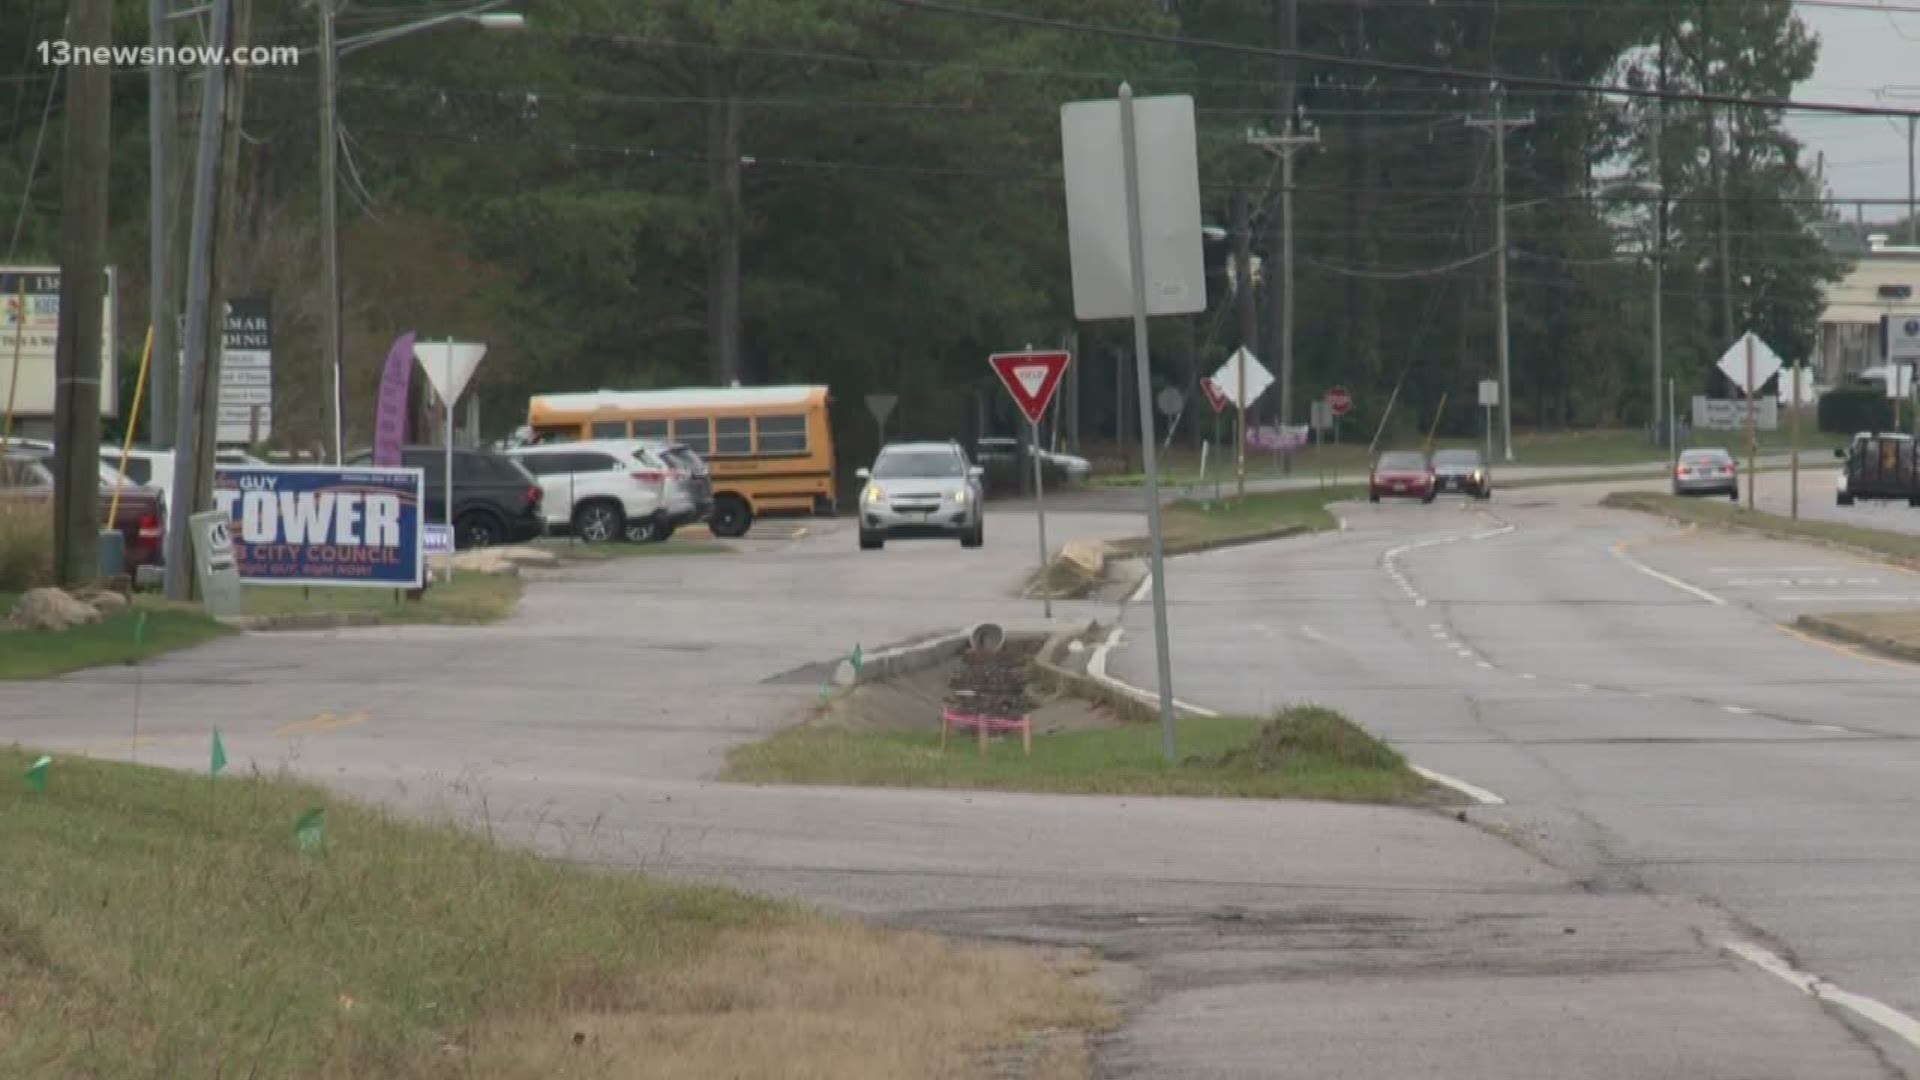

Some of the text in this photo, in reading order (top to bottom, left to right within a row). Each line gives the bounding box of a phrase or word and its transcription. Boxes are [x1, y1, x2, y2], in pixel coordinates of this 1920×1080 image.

[1019, 370, 1045, 380] YIELD
[239, 475, 277, 490] GUY
[213, 489, 400, 546] TOWER
[253, 545, 300, 561] CITY
[307, 546, 400, 564] COUNCIL
